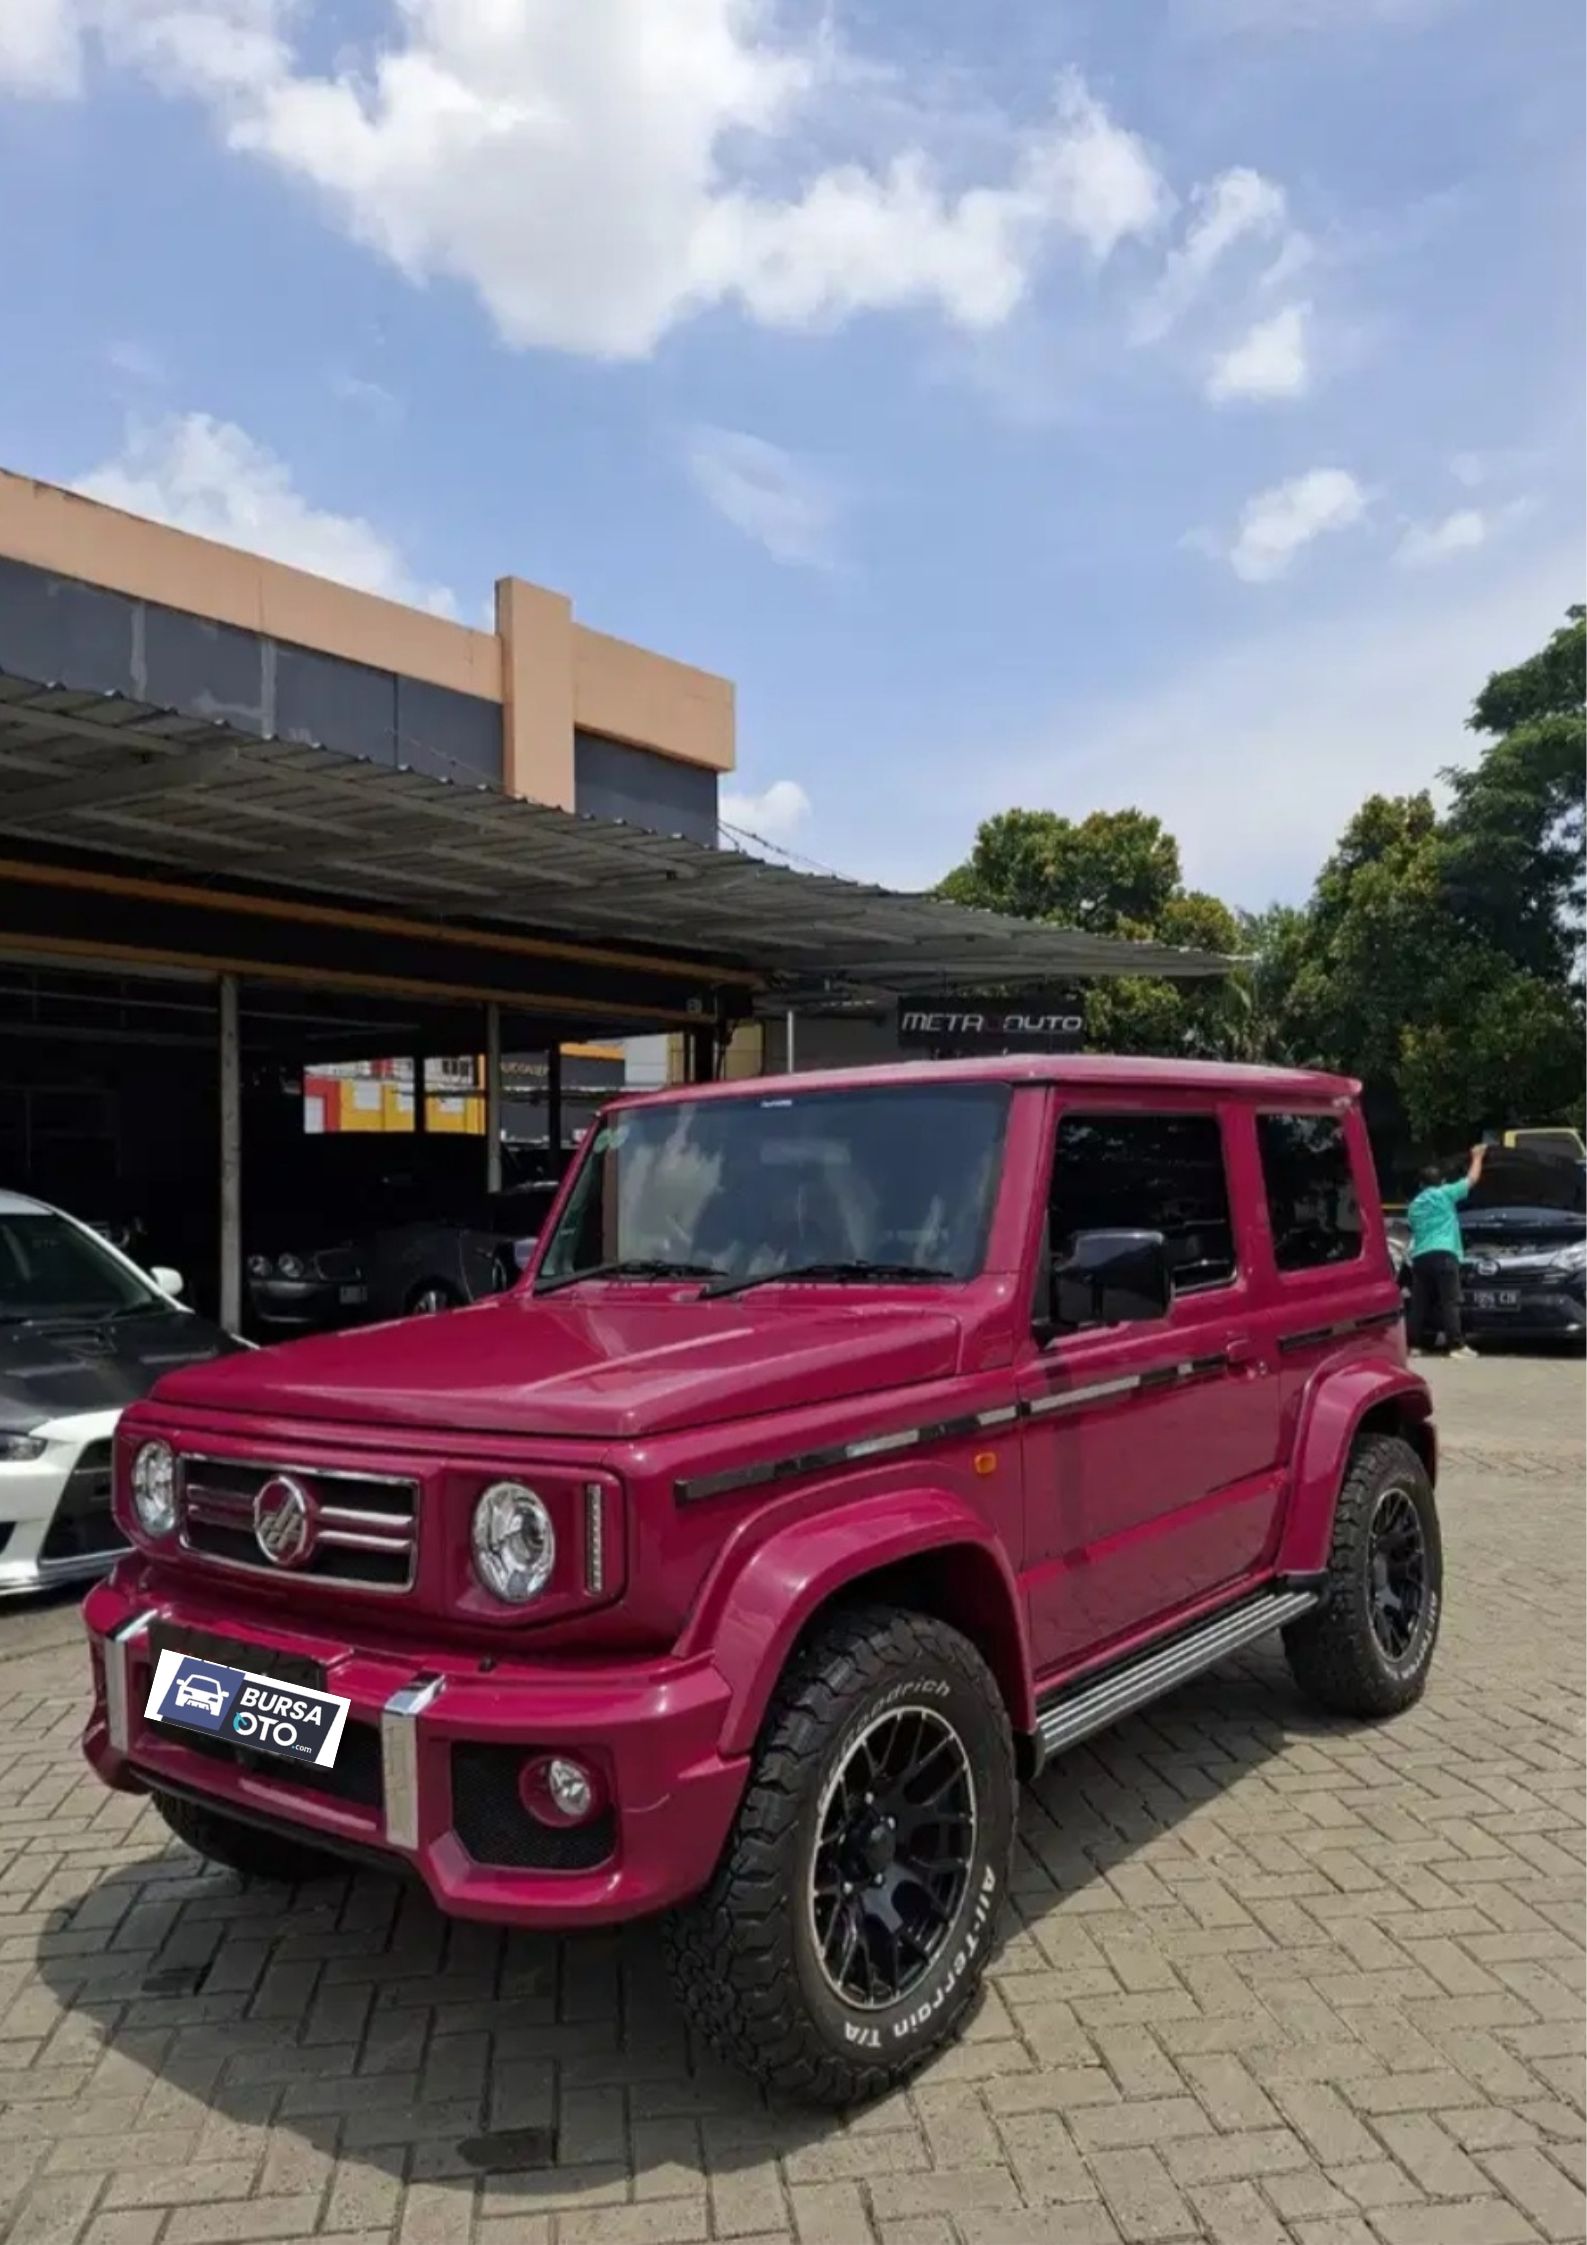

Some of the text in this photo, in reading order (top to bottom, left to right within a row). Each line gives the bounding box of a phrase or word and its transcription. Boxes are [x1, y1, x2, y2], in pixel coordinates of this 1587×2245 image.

[901, 1012, 1083, 1032] META AUTO
[844, 2021, 882, 2048] T/A
